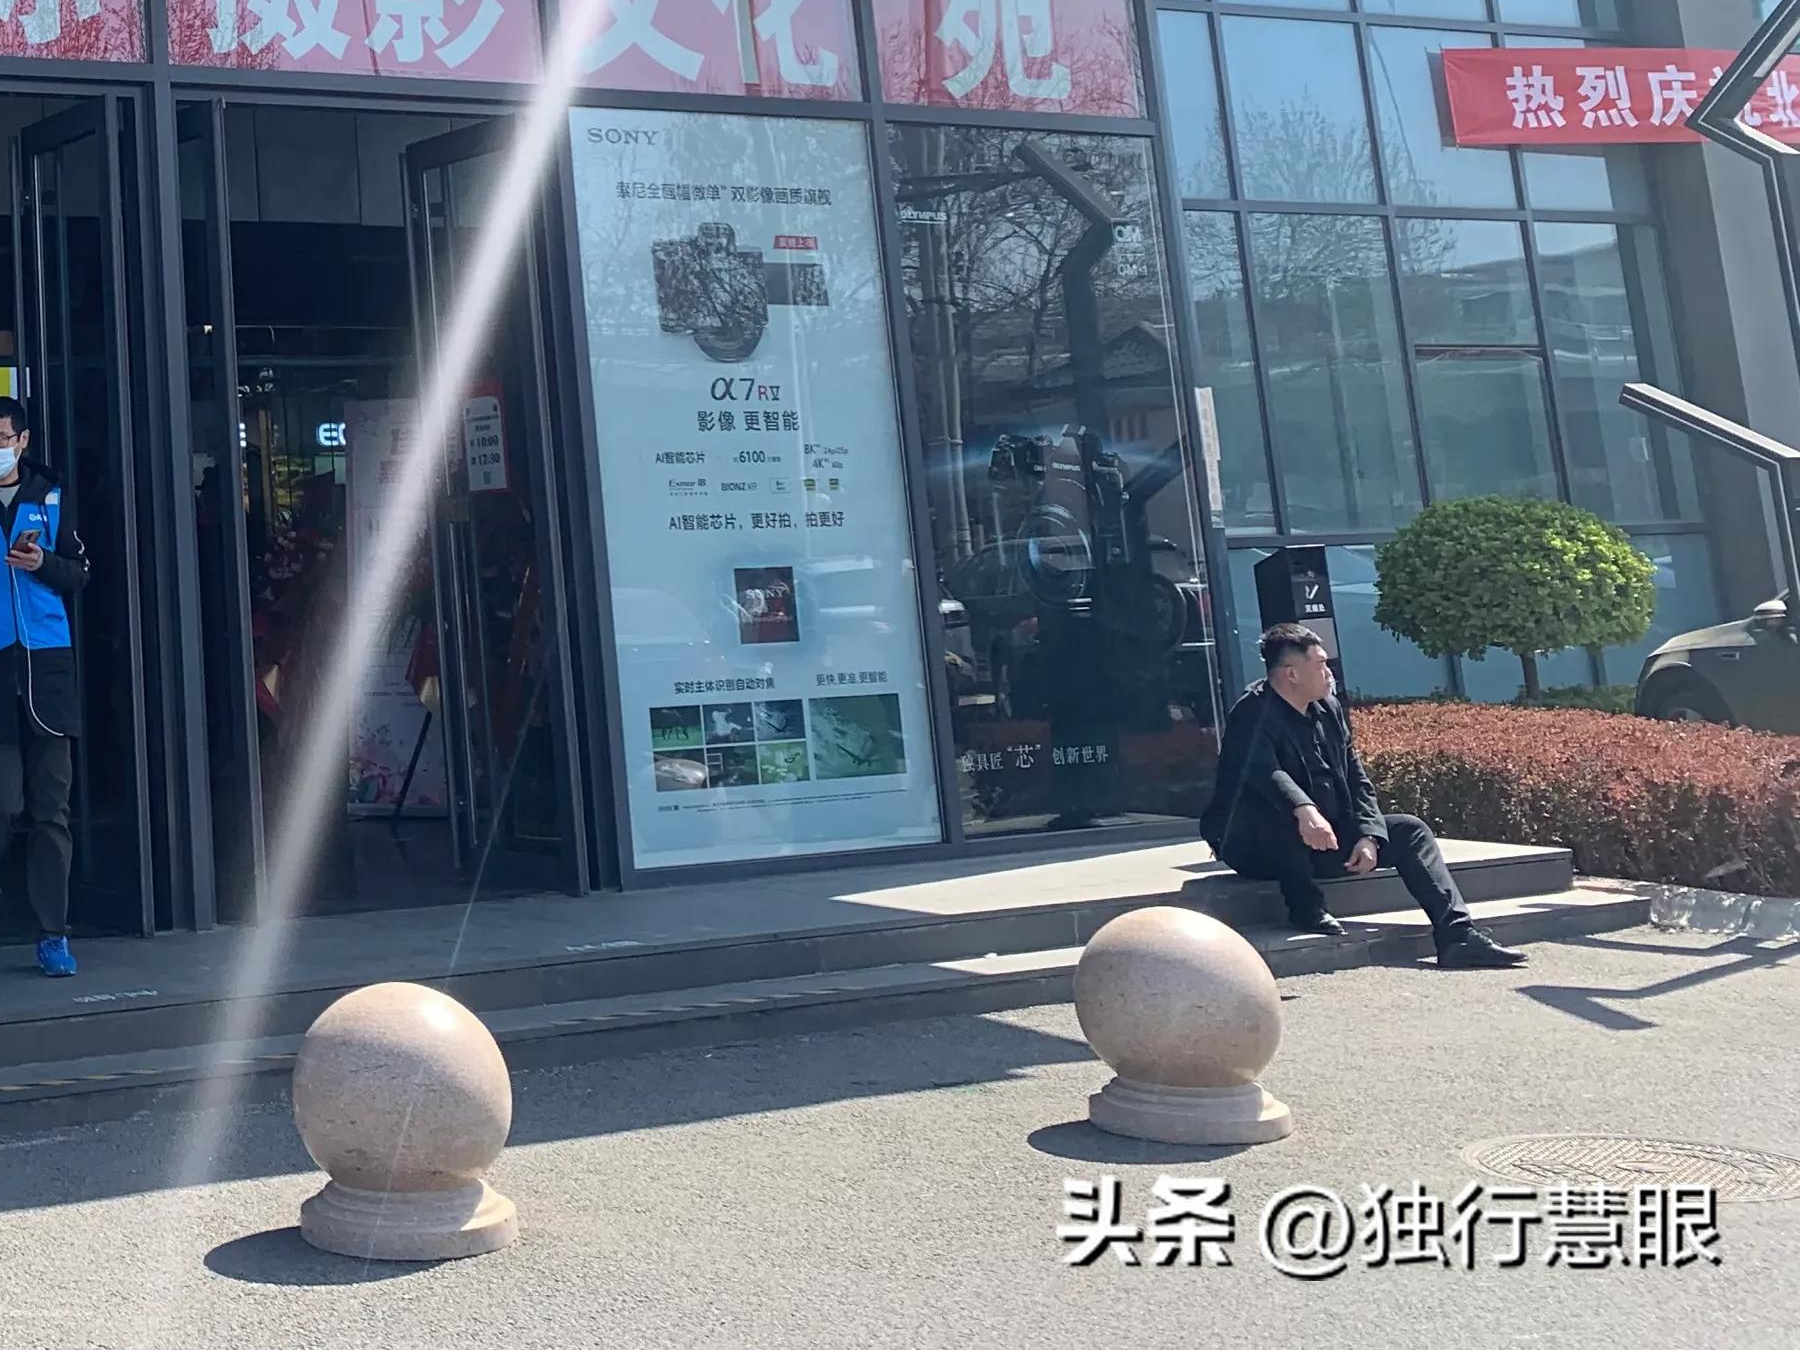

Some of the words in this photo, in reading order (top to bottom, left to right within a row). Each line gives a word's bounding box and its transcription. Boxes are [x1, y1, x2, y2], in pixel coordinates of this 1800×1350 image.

[1505, 64, 1800, 129] 热烈庆北
[587, 128, 659, 146] SONY
[900, 210, 947, 220] OLYMPUS
[697, 411, 736, 431] 影像
[744, 411, 800, 431] 更智能
